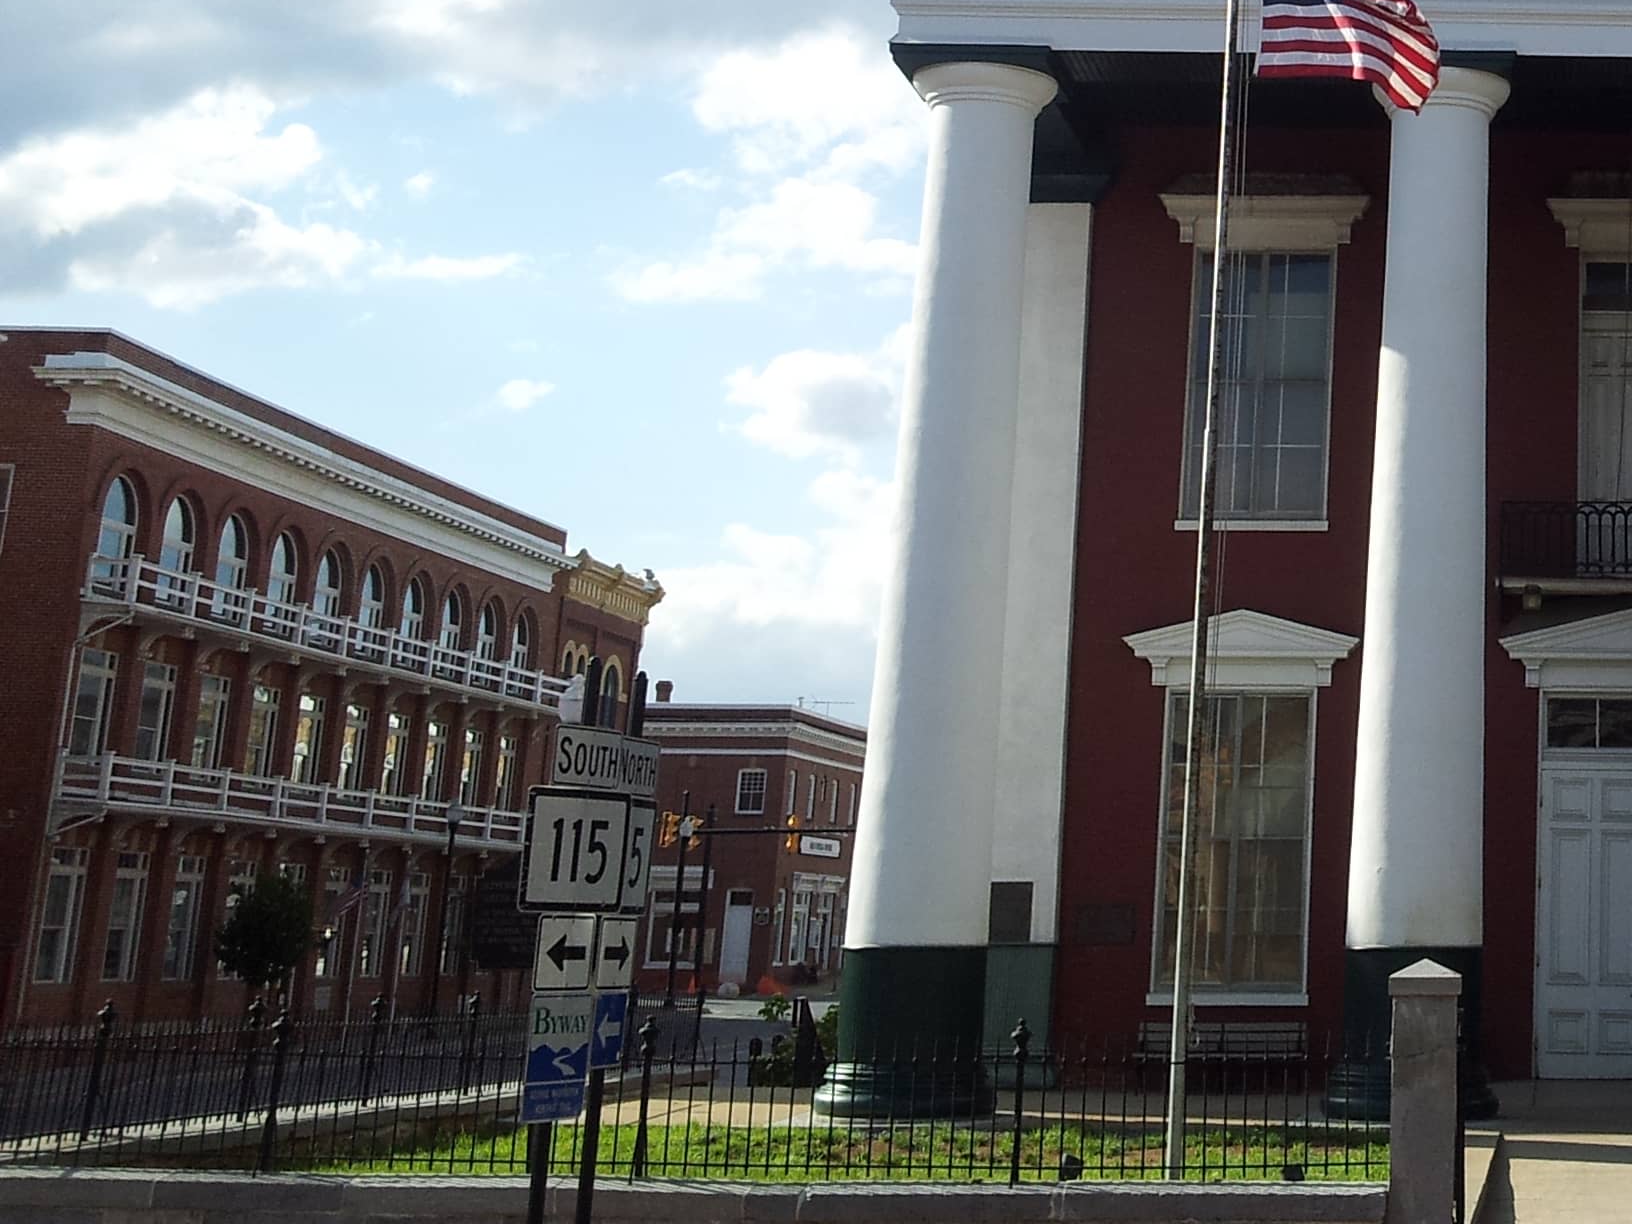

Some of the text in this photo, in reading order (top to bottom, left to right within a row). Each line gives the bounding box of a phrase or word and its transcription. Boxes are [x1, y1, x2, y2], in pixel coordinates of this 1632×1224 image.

[558, 736, 619, 778] SOUTH
[622, 746, 656, 787] NORTH
[550, 817, 609, 885] 115
[534, 1008, 587, 1034] BYWAY
